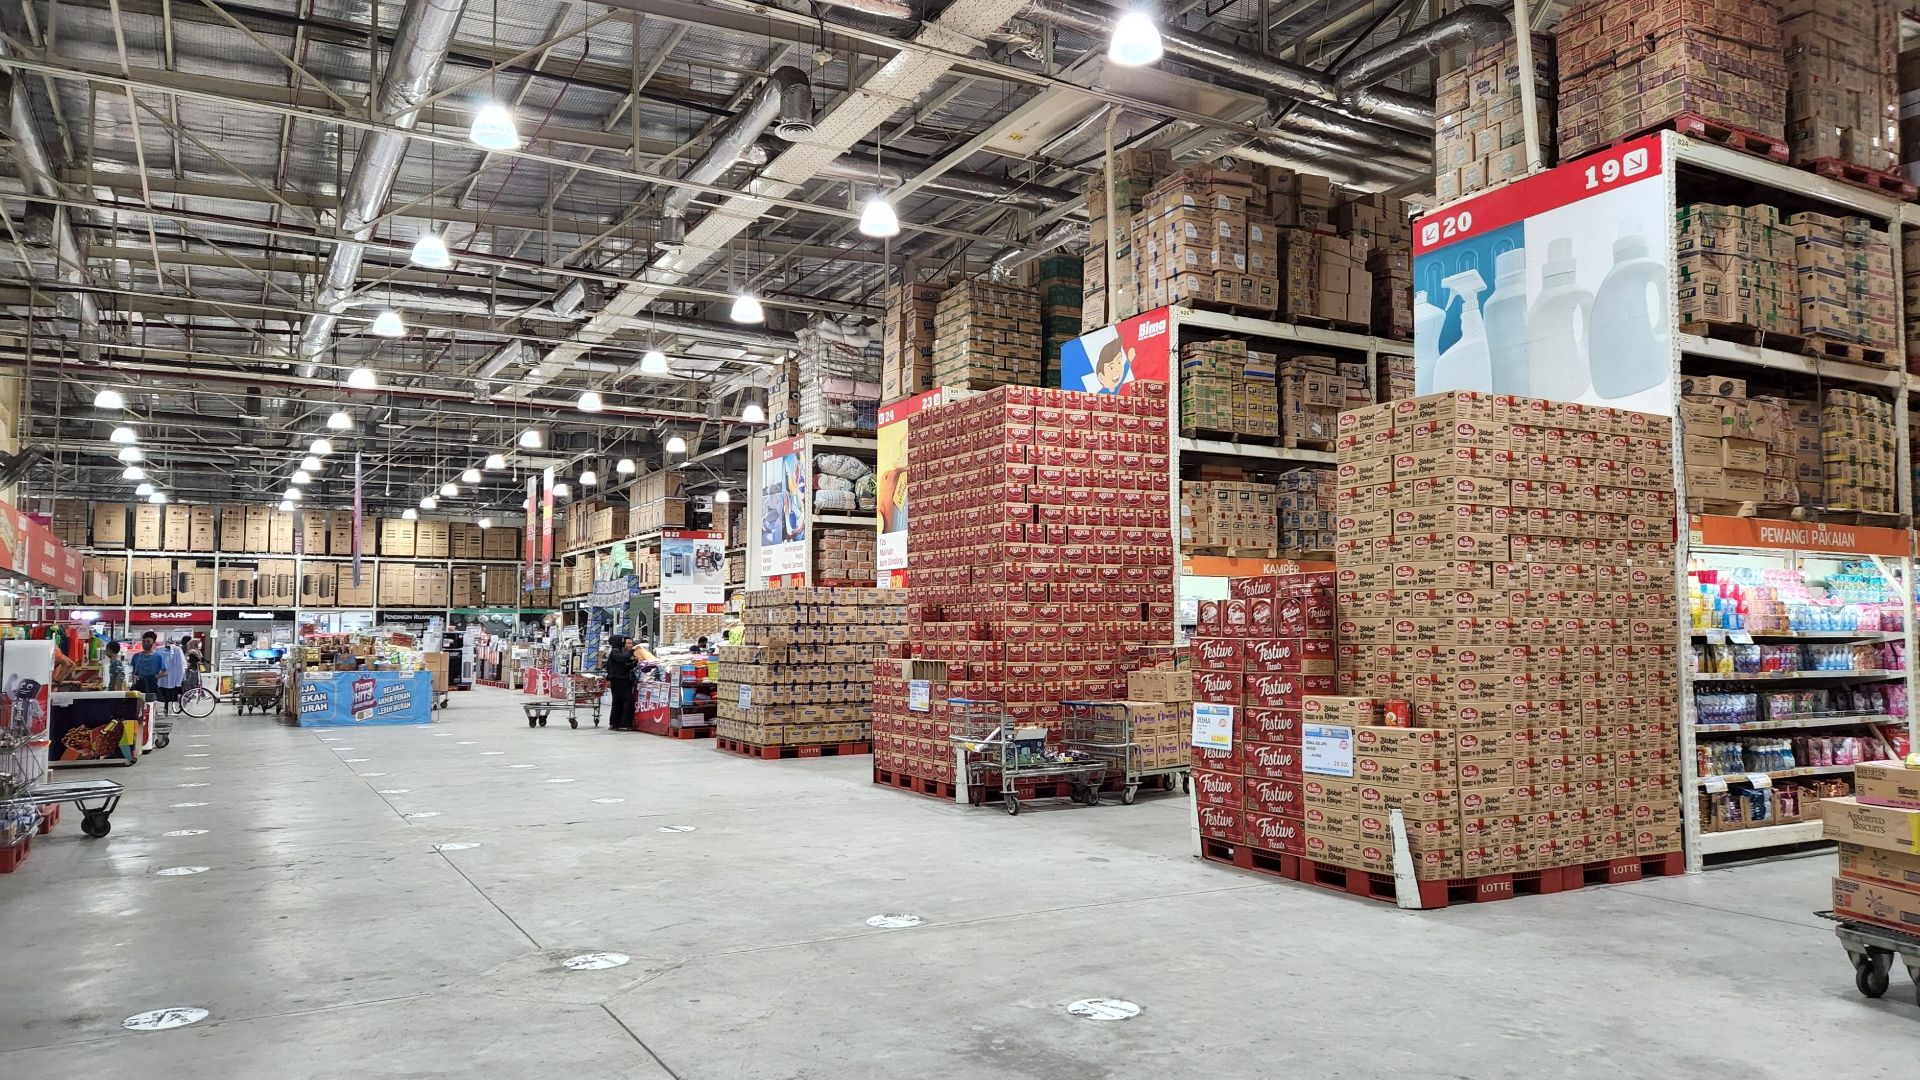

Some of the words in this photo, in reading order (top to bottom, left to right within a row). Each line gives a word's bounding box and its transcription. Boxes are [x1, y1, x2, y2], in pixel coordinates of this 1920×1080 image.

[1585, 165, 1620, 190] 19
[1442, 211, 1472, 239] 20
[921, 288, 938, 298] nice
[1138, 319, 1167, 337] Bima
[922, 396, 933, 410] 23
[885, 409, 895, 421] 24
[1071, 491, 1088, 499] ASTOR
[1761, 526, 1808, 545] PEWANGI
[1811, 530, 1855, 547] PAKAIAN
[1103, 568, 1119, 576] ASTOR
[1263, 563, 1300, 575] KAMPER
[1239, 577, 1272, 597] Festive
[1012, 606, 1029, 614] ASTOR
[1308, 607, 1331, 618] Festive
[1011, 626, 1029, 634] ASTOR
[1067, 626, 1085, 634] ASTOR
[1200, 640, 1234, 660] Festive
[1255, 641, 1291, 662] Festive
[1012, 666, 1030, 674] ASTOR
[1094, 664, 1111, 672] ASTOR
[354, 681, 373, 691] Promo
[1201, 673, 1233, 693] Festive
[1256, 676, 1293, 697] Festive
[355, 689, 373, 703] HITS
[1041, 706, 1058, 714] ASTOR
[1256, 711, 1293, 732] Festive
[1255, 746, 1293, 767] Festive
[1200, 774, 1233, 793] Festive
[1257, 782, 1294, 802] Festive
[1897, 786, 1919, 796] Rinso
[1201, 808, 1235, 827] Festive
[1847, 811, 1885, 825] ASSORTED
[1256, 817, 1296, 839] Festive
[1853, 821, 1886, 834] BISCUITS
[1613, 864, 1639, 875] LOTTE
[1481, 881, 1511, 893] LOTTE
